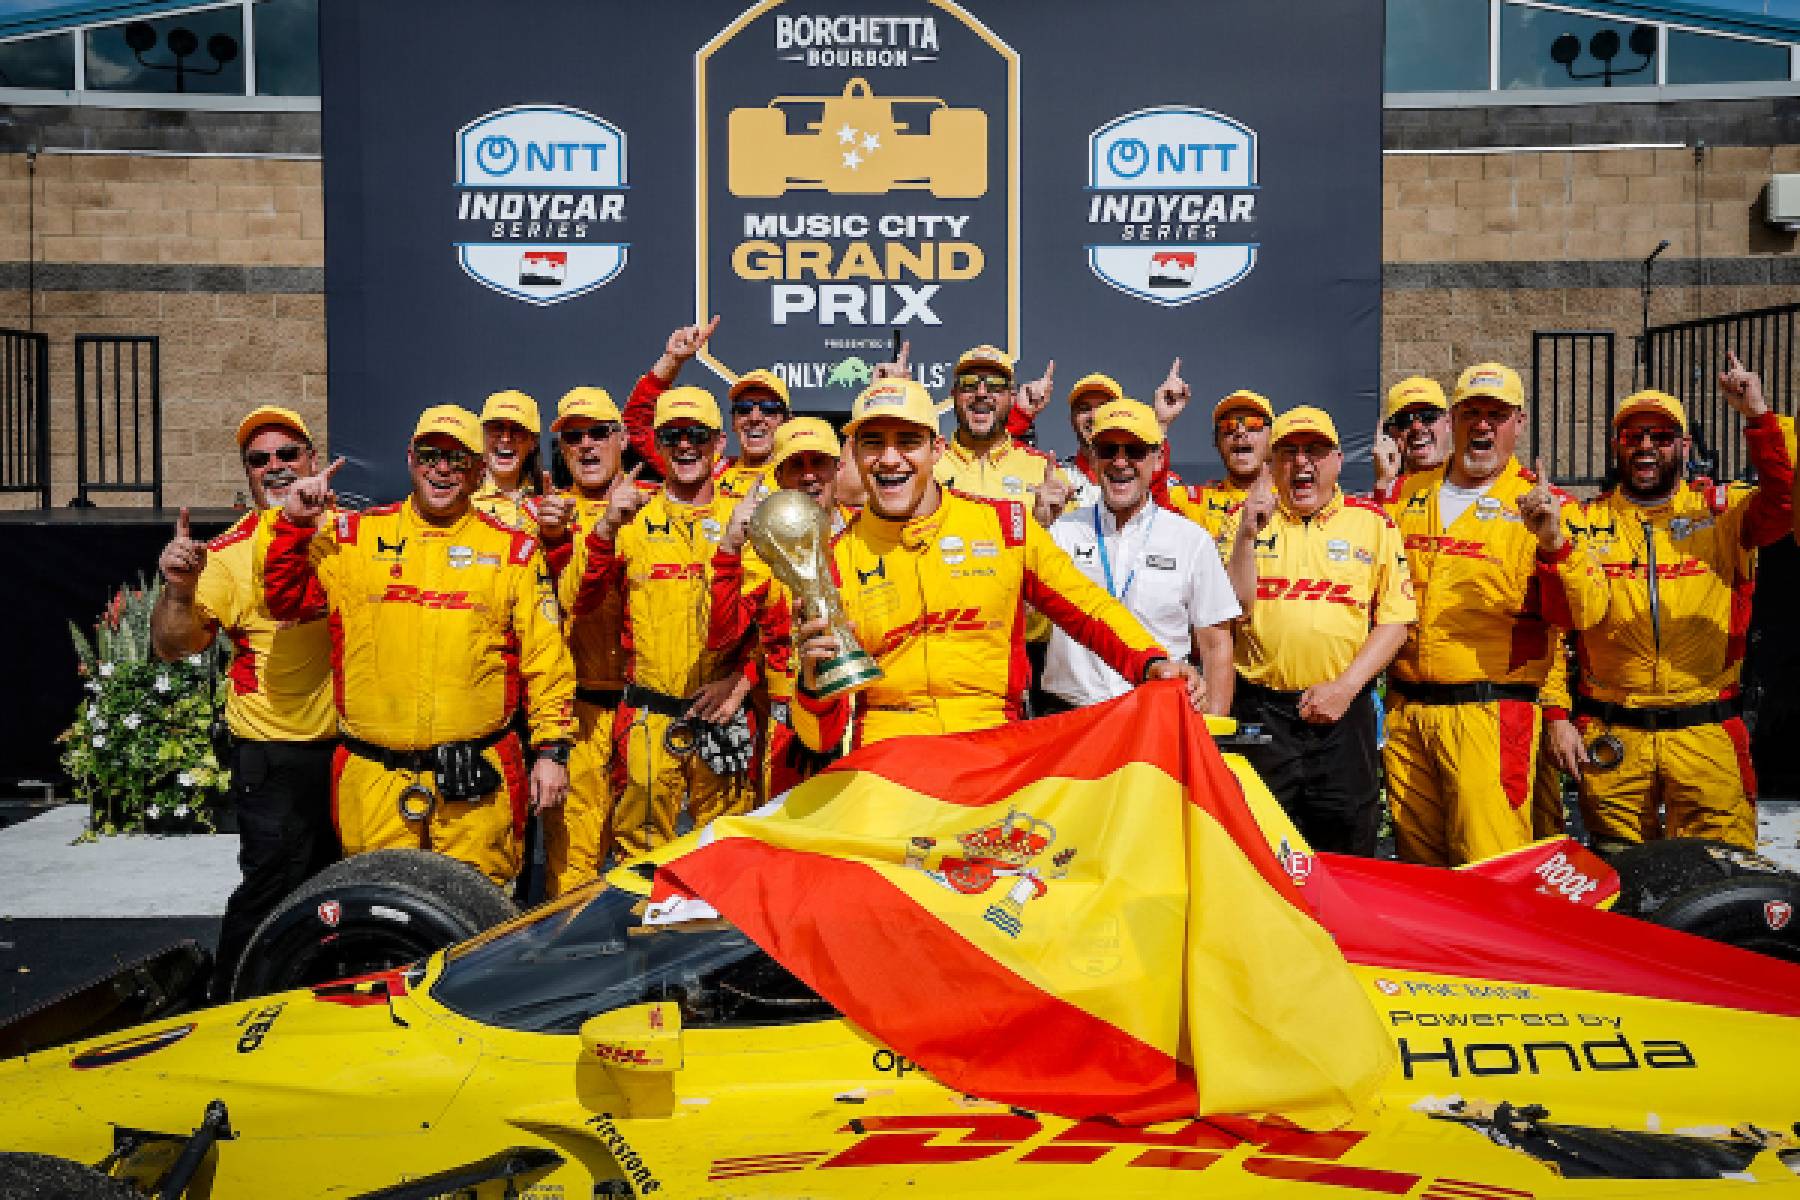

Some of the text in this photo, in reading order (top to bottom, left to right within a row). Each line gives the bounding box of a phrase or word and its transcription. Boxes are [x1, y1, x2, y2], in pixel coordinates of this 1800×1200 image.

[776, 15, 940, 52] BORCHETTA
[806, 48, 908, 67] BOURBON
[526, 141, 607, 172] NTT
[1157, 143, 1239, 173] NTT
[458, 191, 627, 221] INDYCAR
[1088, 194, 1257, 223] INDYCAR
[491, 221, 588, 238] SERIES
[743, 213, 970, 238] MUSIC CITY
[1121, 224, 1217, 240] SERIES
[731, 240, 985, 280] GRAND
[771, 284, 943, 324] PRIX
[382, 585, 474, 609] DHL
[1256, 577, 1357, 606] DHL
[1389, 1010, 1622, 1029] Powered by
[1397, 1032, 1697, 1080] Honda
[585, 1112, 662, 1195] Firestone
[816, 1114, 1422, 1195] DHL
